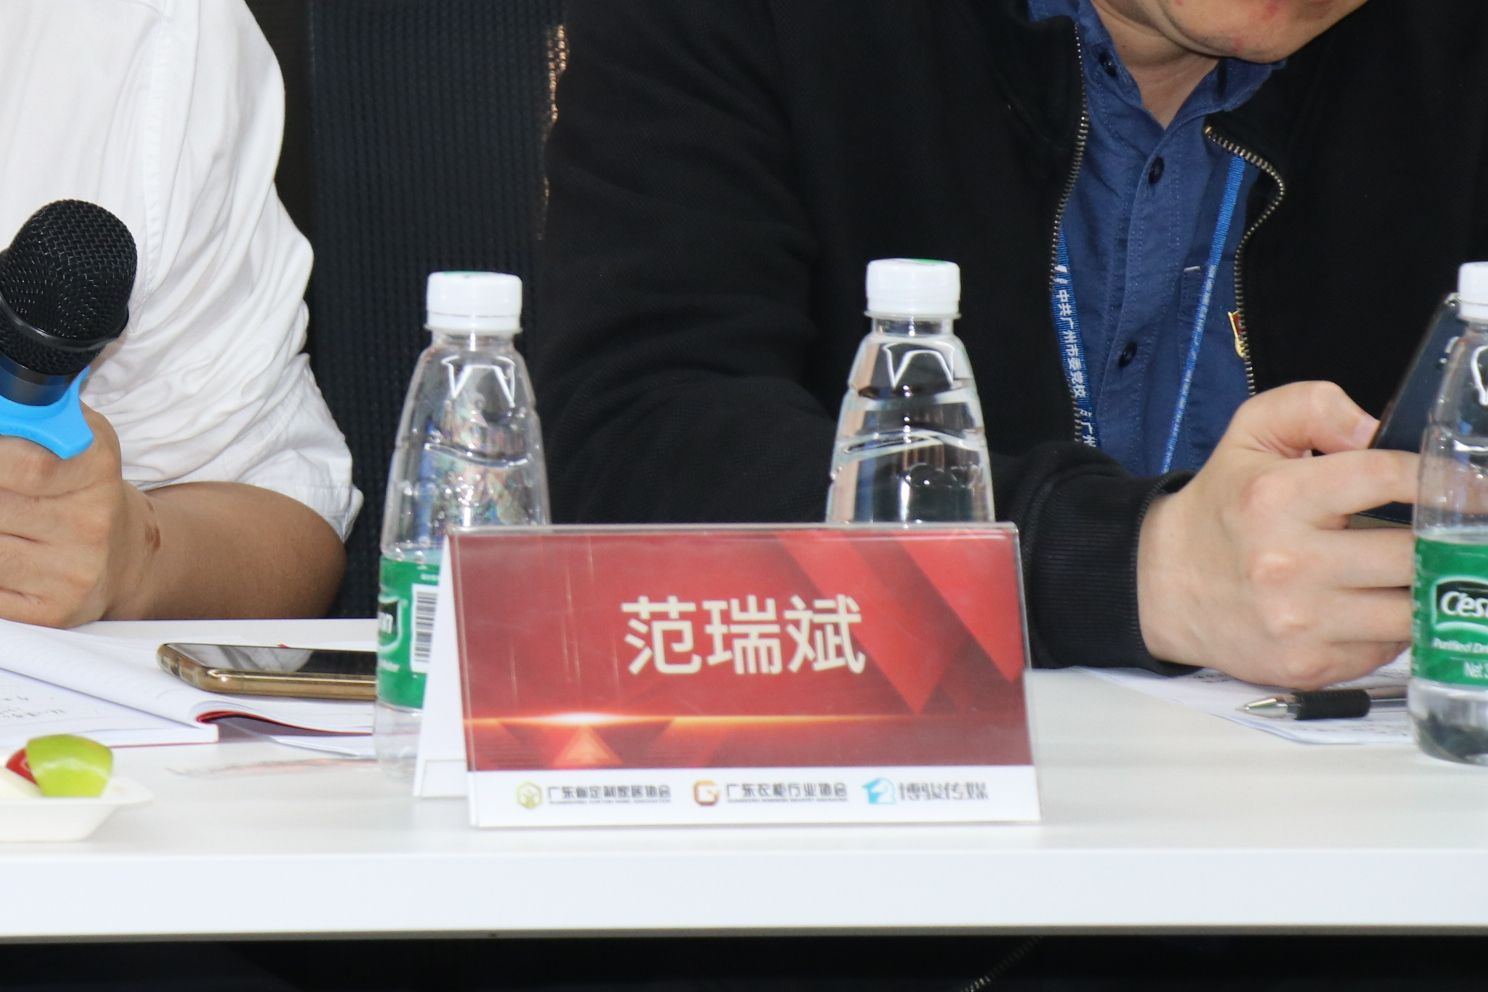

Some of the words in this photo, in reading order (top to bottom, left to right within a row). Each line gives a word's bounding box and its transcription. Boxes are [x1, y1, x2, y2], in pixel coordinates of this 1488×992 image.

[1055, 289, 1087, 399] 中共广州市委党校
[621, 594, 866, 676] 范瑞斌
